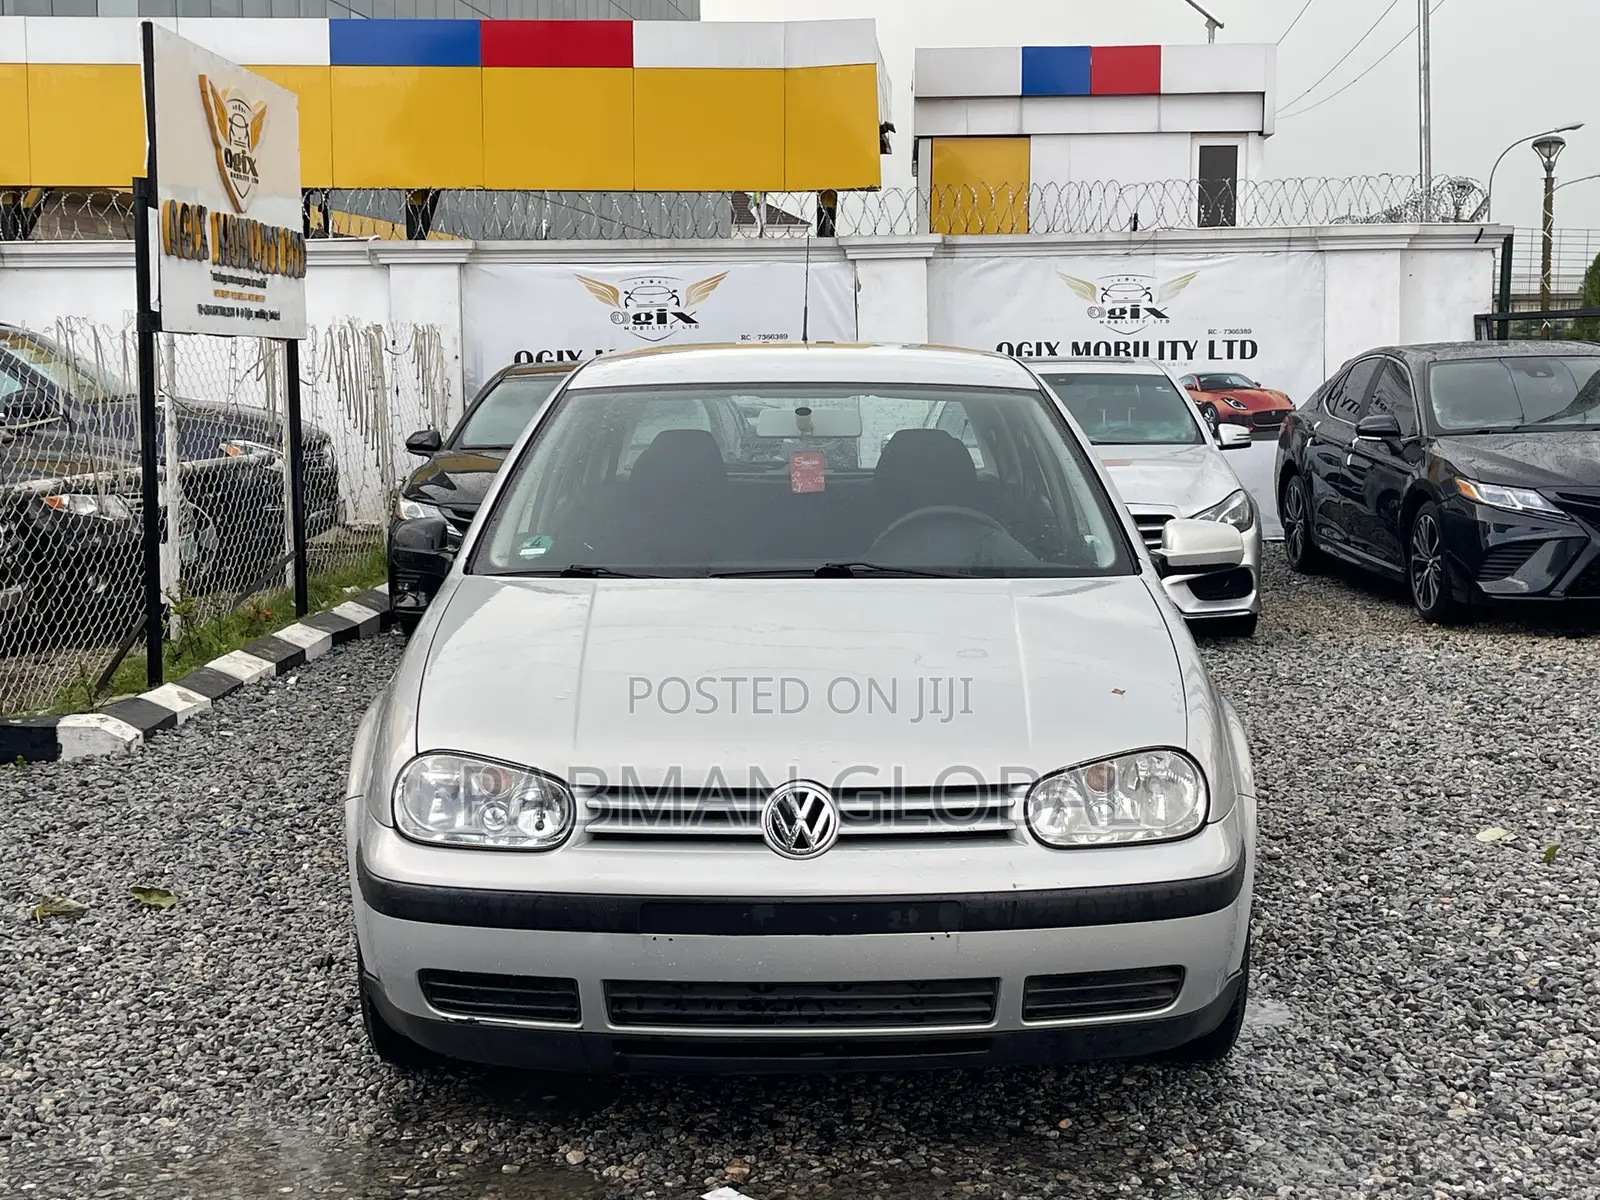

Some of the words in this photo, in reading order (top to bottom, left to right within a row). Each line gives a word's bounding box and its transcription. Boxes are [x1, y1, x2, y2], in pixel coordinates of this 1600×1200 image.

[610, 308, 699, 326] Ogix
[1087, 304, 1170, 320] Ogix
[996, 341, 1060, 357] OGIX
[1071, 340, 1199, 361] MOBILITY
[1208, 339, 1259, 360] LTD
